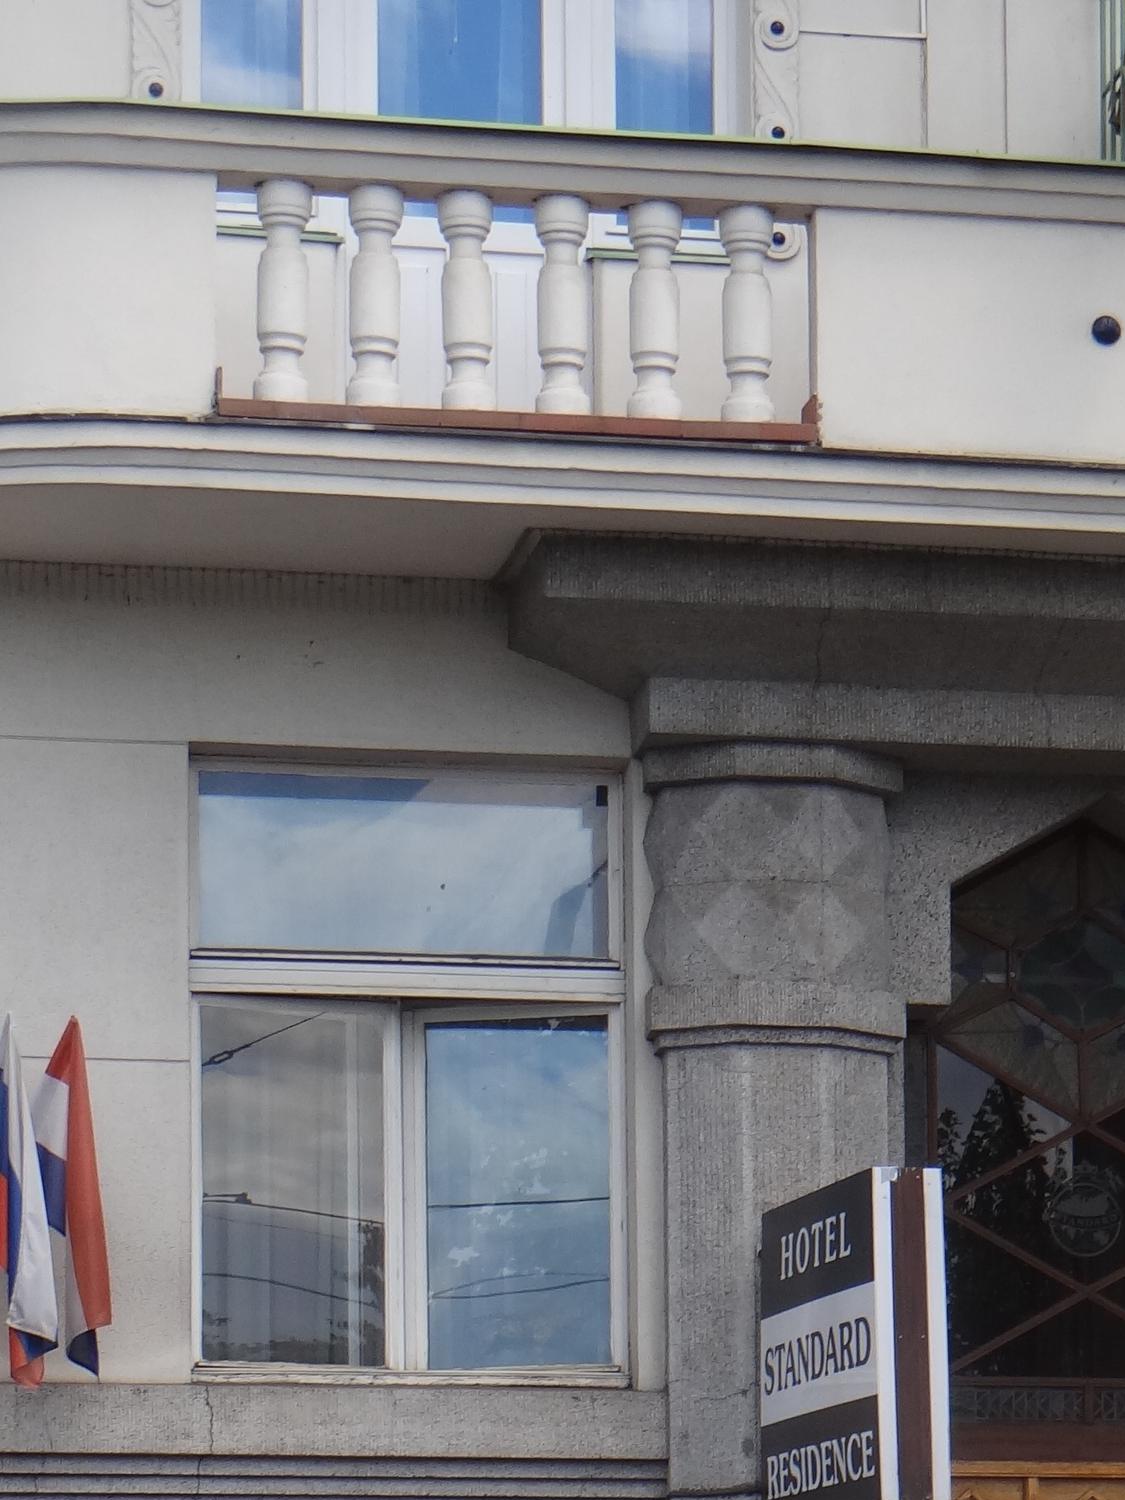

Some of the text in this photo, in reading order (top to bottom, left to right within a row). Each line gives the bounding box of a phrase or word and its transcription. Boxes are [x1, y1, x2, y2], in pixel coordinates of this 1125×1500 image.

[780, 1212, 852, 1281] HOTEL
[763, 1316, 872, 1396] STANDARD
[766, 1430, 876, 1500] RESIDENCE
